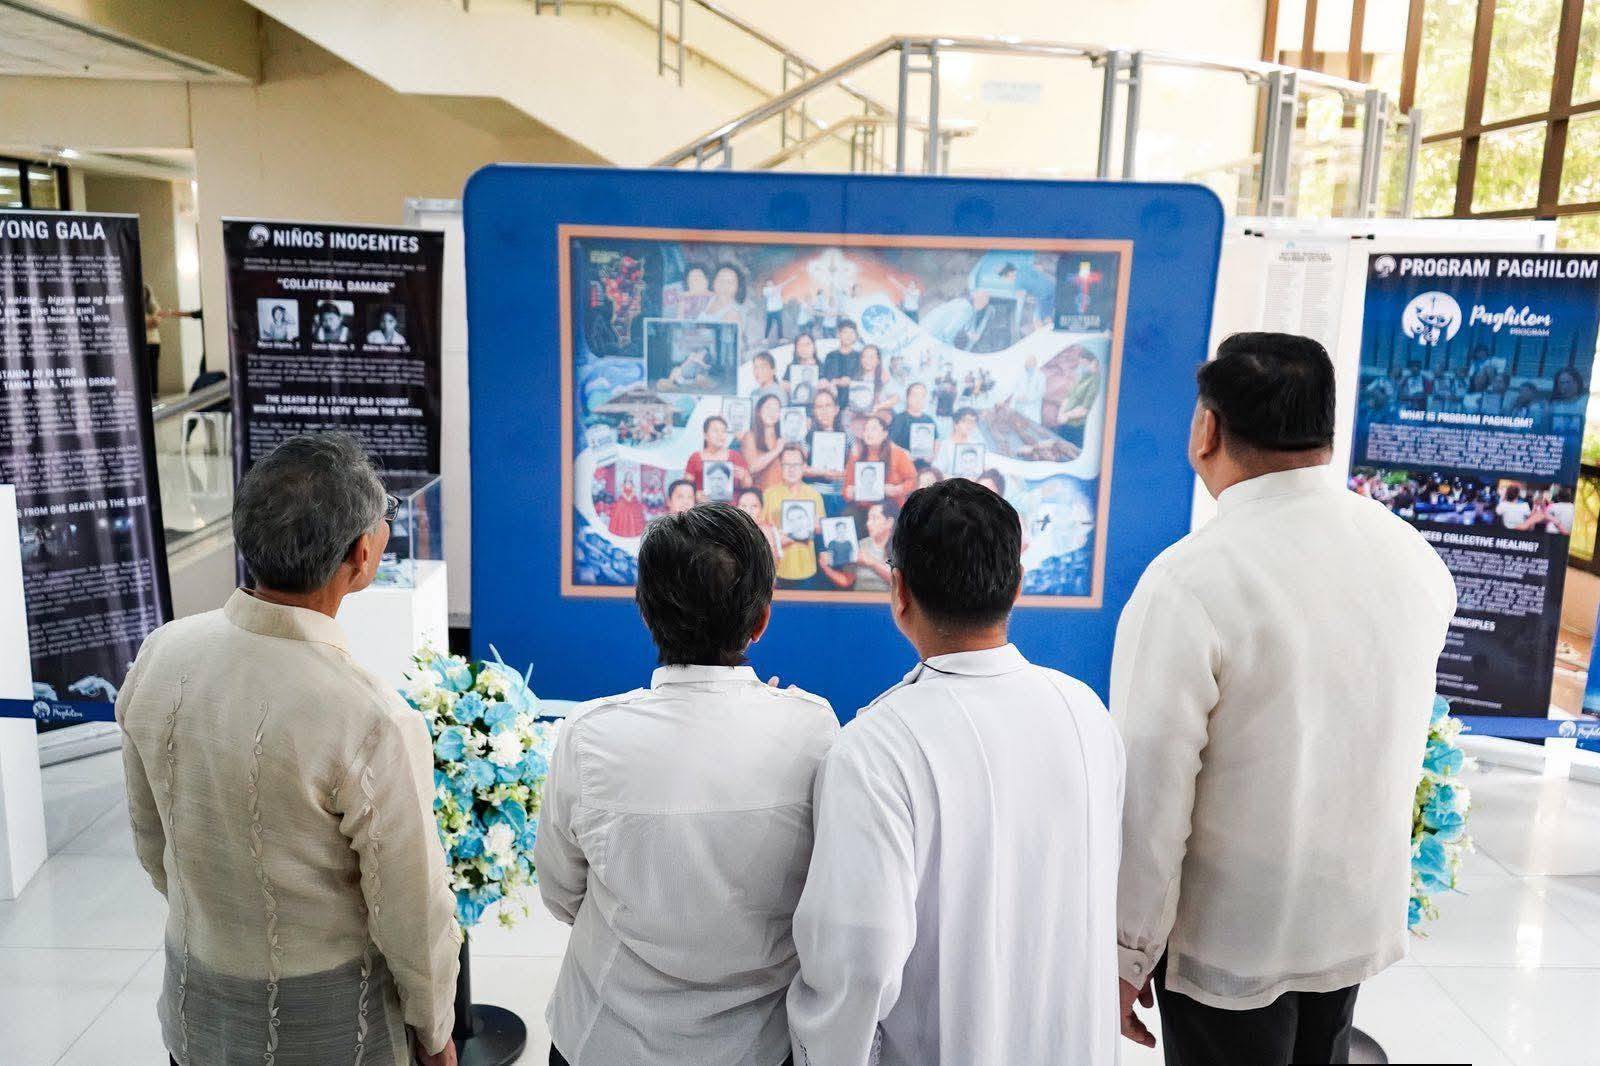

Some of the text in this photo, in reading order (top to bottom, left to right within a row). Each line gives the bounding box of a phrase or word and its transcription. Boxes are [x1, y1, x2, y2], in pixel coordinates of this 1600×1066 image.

[55, 221, 107, 240] GALA
[273, 227, 420, 253] NIÑOS INOCENTES
[1400, 257, 1599, 279] PROGRAM PAGHILOM
[1469, 304, 1552, 333] Paghilom
[1400, 409, 1425, 421] WHAT
[24, 507, 48, 517] FROM
[1443, 532, 1495, 548] COLLECTIVE
[1495, 538, 1540, 552] HEALING?
[1451, 616, 1496, 631] RINCIPLES
